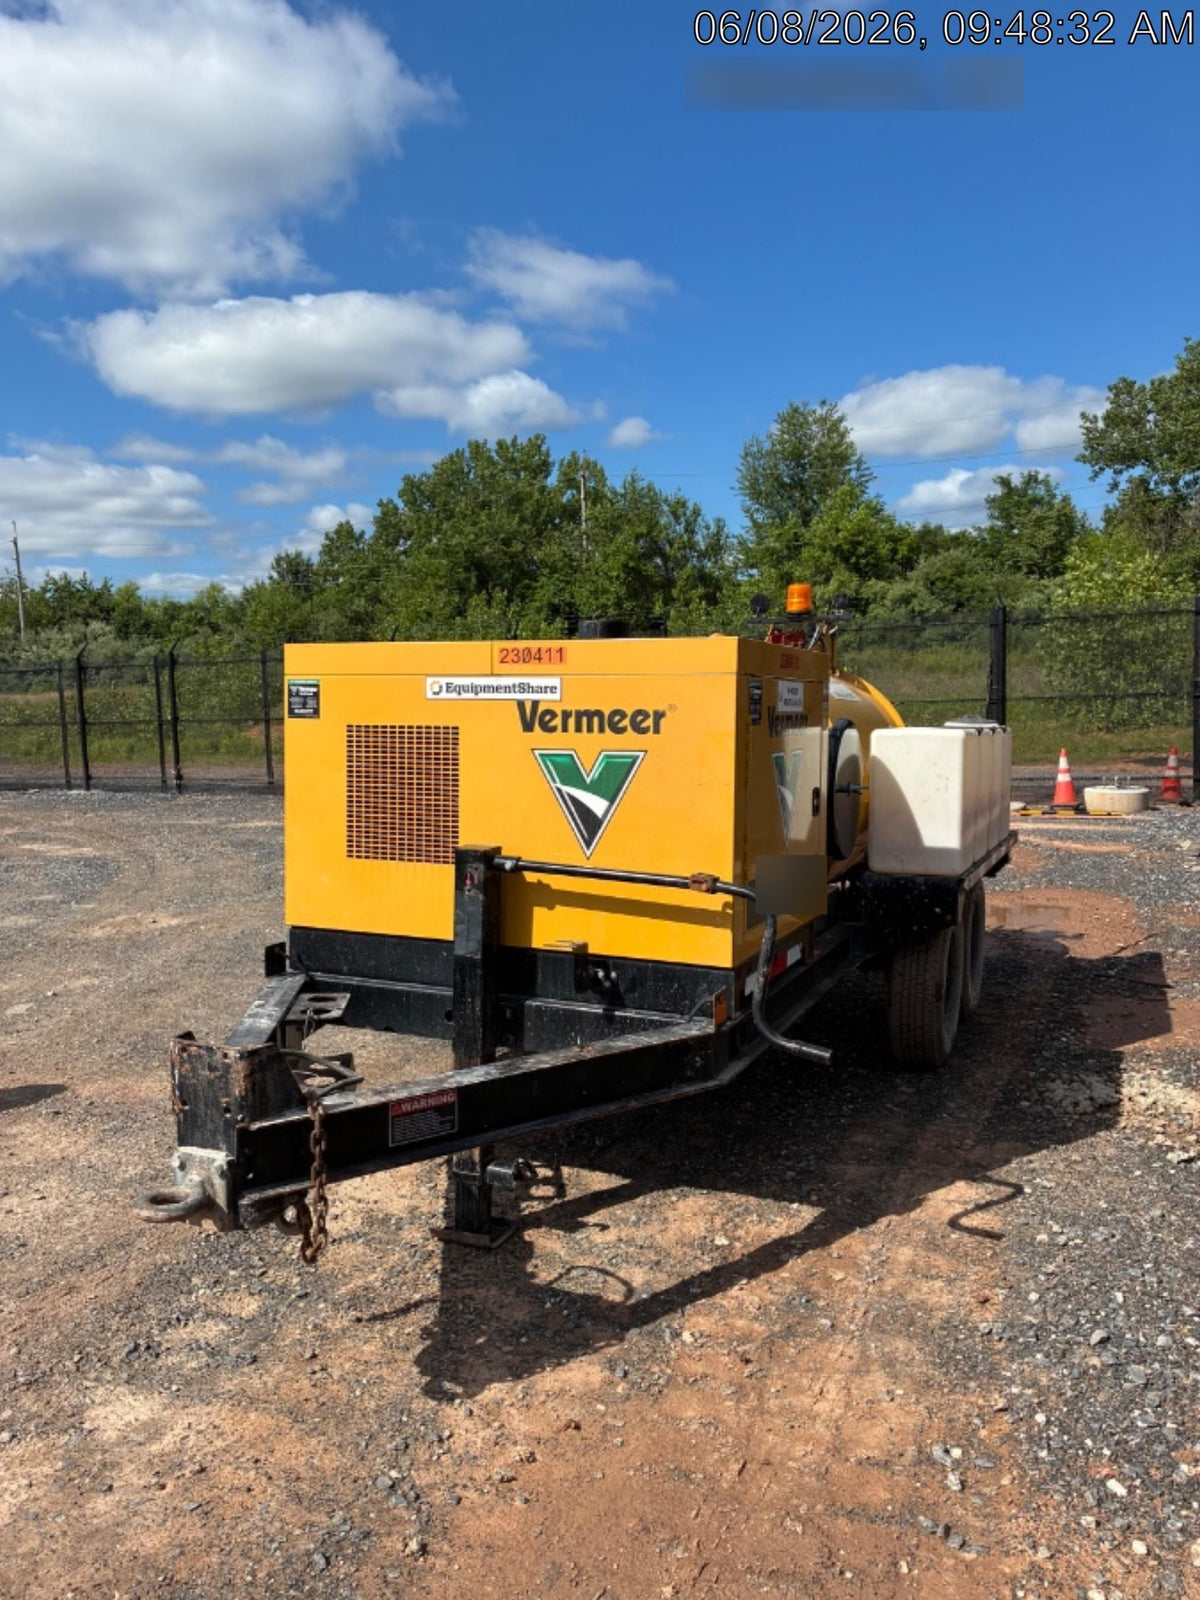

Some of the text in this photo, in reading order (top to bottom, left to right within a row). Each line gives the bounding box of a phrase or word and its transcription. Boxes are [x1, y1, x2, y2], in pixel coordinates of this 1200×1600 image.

[499, 647, 565, 664] 230411
[445, 682, 558, 695] EquipmentShare
[517, 700, 666, 734] Vermeer
[401, 1093, 455, 1112] WARNING
